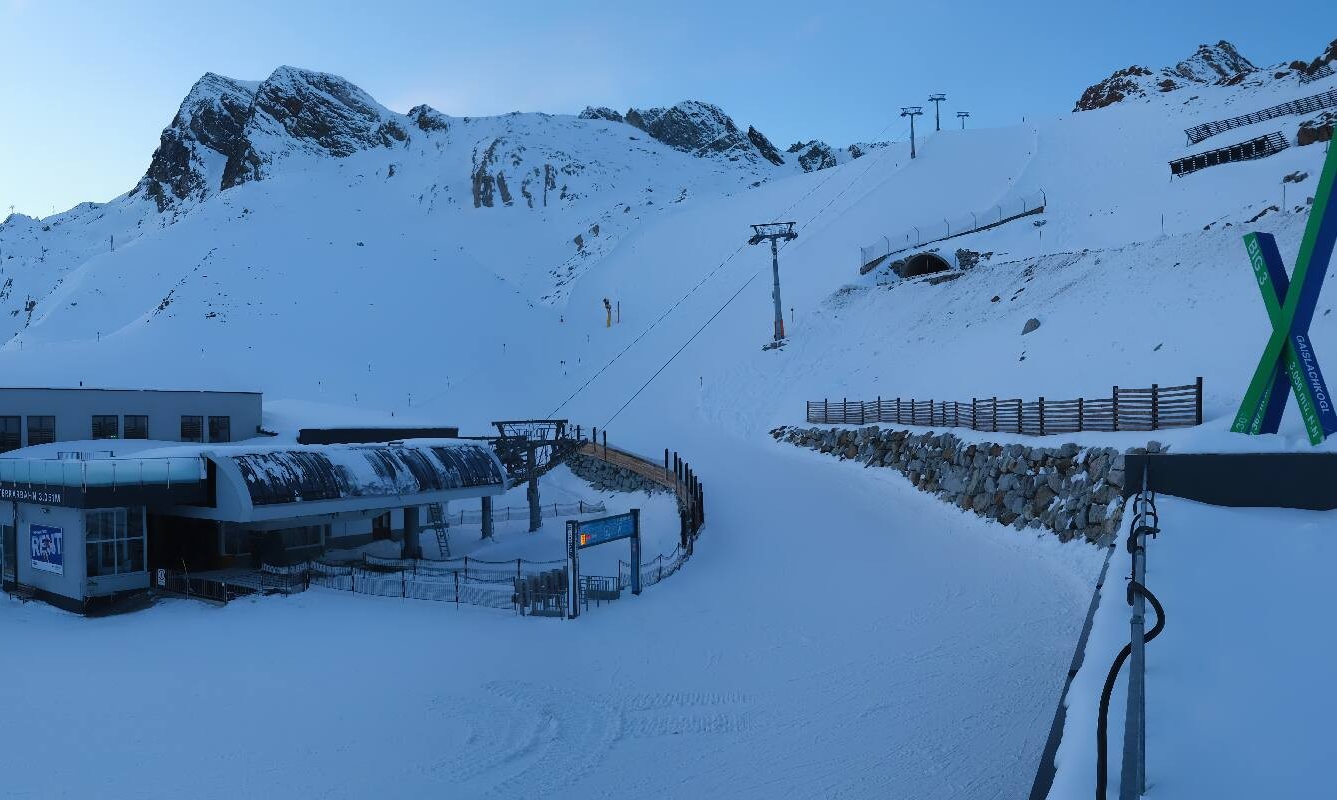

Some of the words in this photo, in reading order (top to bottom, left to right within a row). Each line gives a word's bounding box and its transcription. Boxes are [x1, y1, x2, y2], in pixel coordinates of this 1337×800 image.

[1248, 237, 1263, 272] BIG
[1259, 271, 1268, 286] 3
[1296, 335, 1330, 414] GAISLACHKOGL
